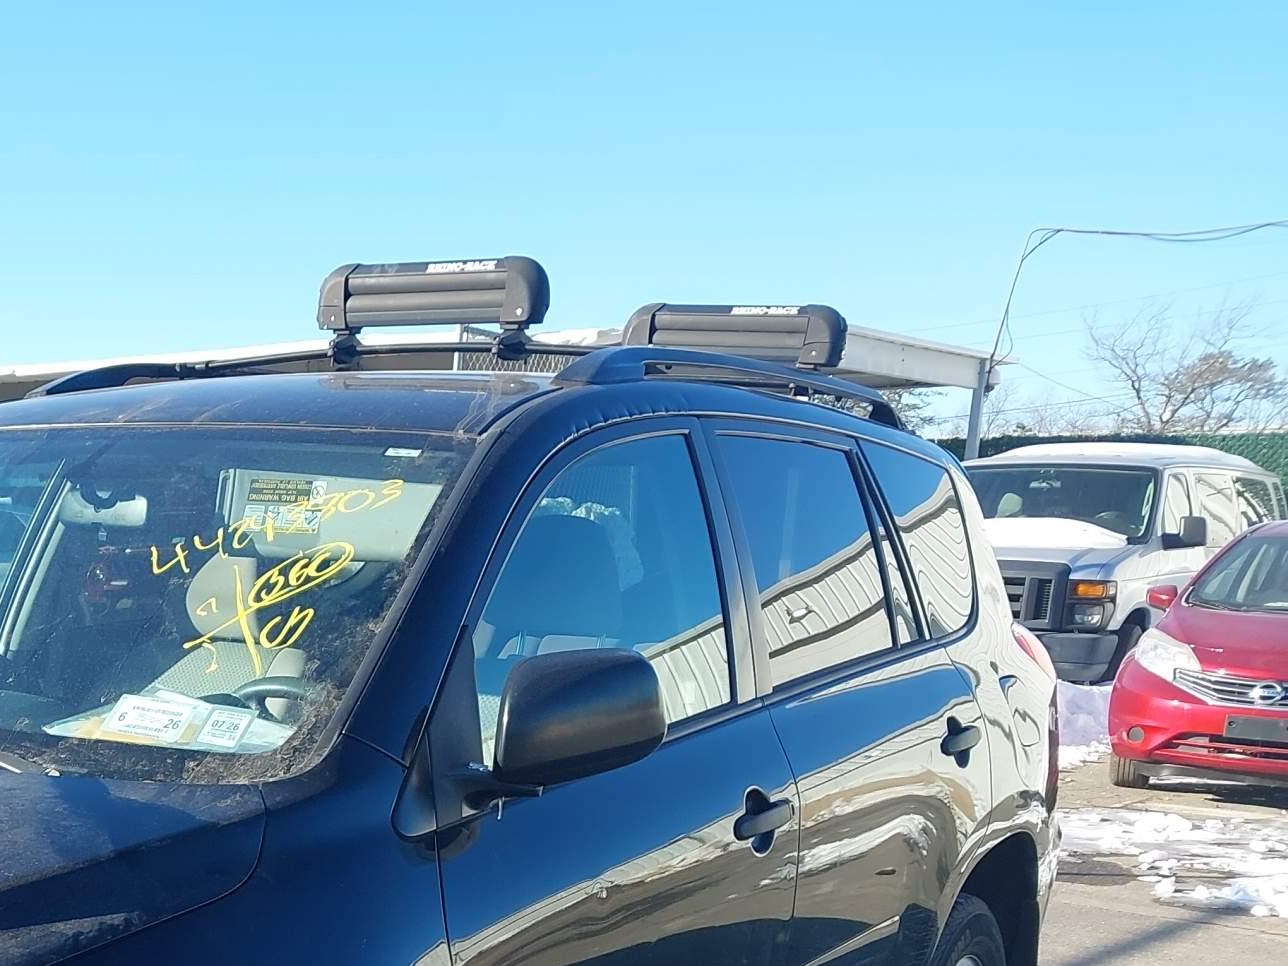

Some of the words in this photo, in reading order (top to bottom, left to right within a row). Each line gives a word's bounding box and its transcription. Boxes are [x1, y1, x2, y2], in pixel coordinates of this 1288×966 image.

[248, 493, 280, 501] WARNING
[281, 494, 297, 502] BAG
[117, 711, 128, 722] 6
[163, 718, 182, 730] 26
